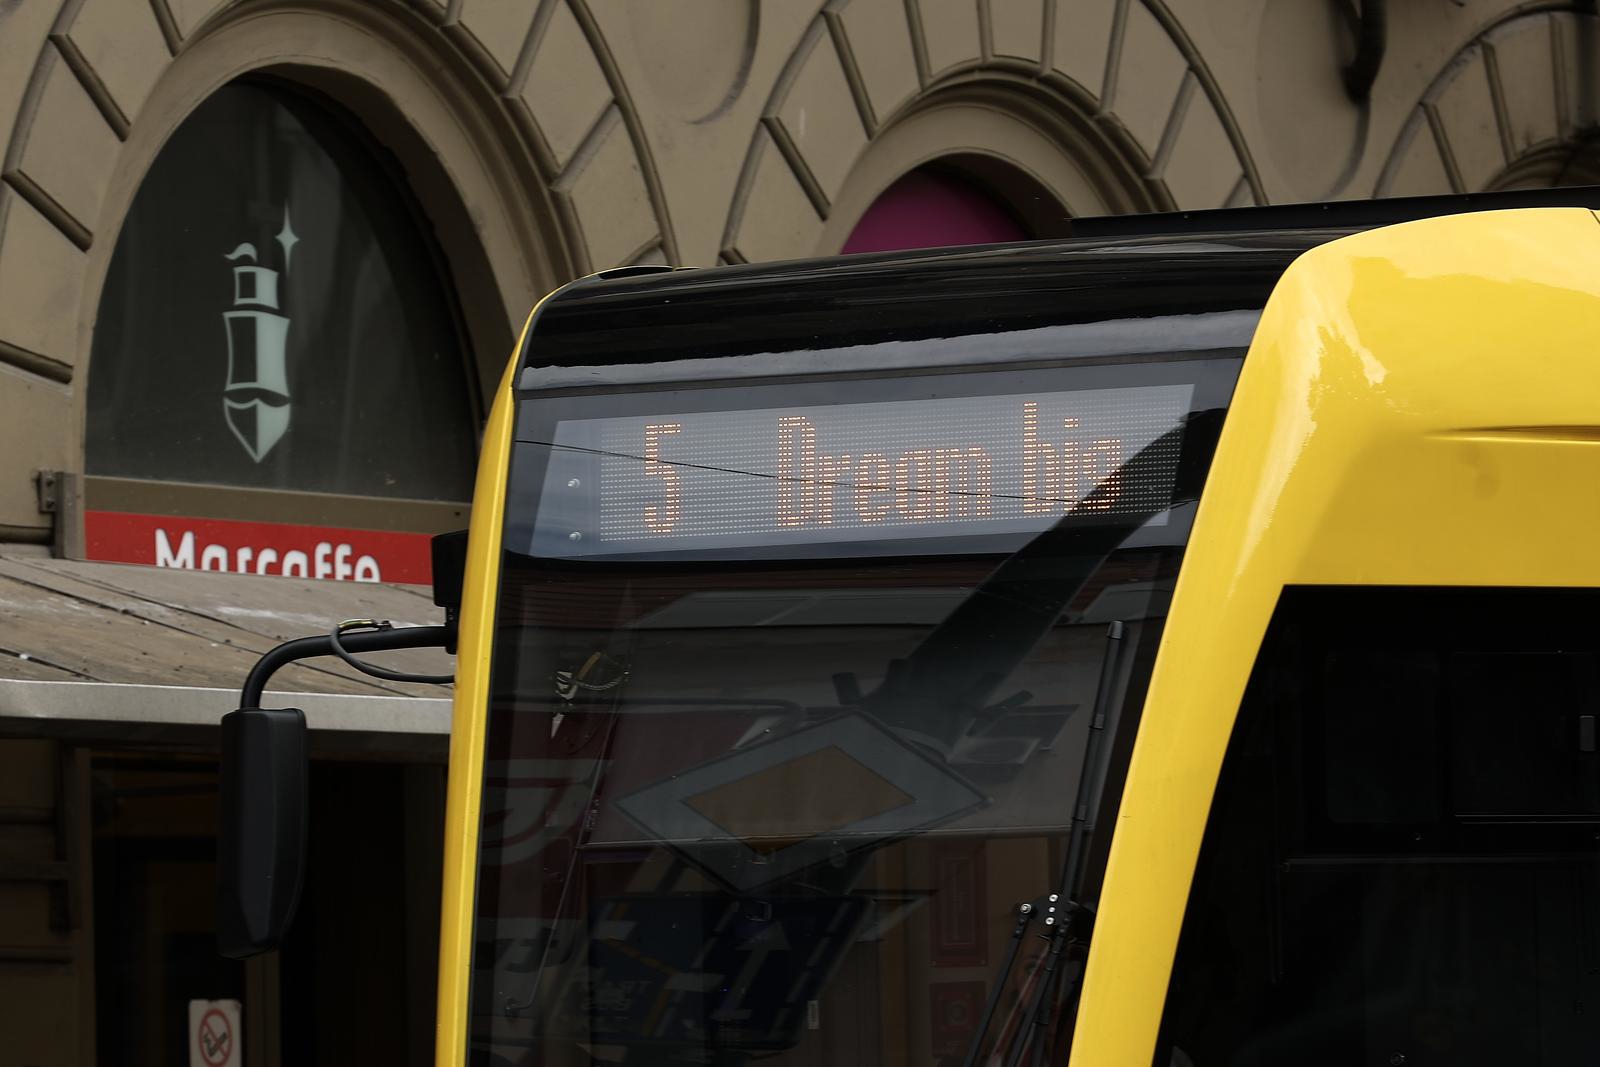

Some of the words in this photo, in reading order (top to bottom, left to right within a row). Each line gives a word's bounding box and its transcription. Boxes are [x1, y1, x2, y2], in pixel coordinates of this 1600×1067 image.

[645, 424, 681, 534] 5
[777, 416, 992, 526] Dream
[1023, 402, 1121, 513] big
